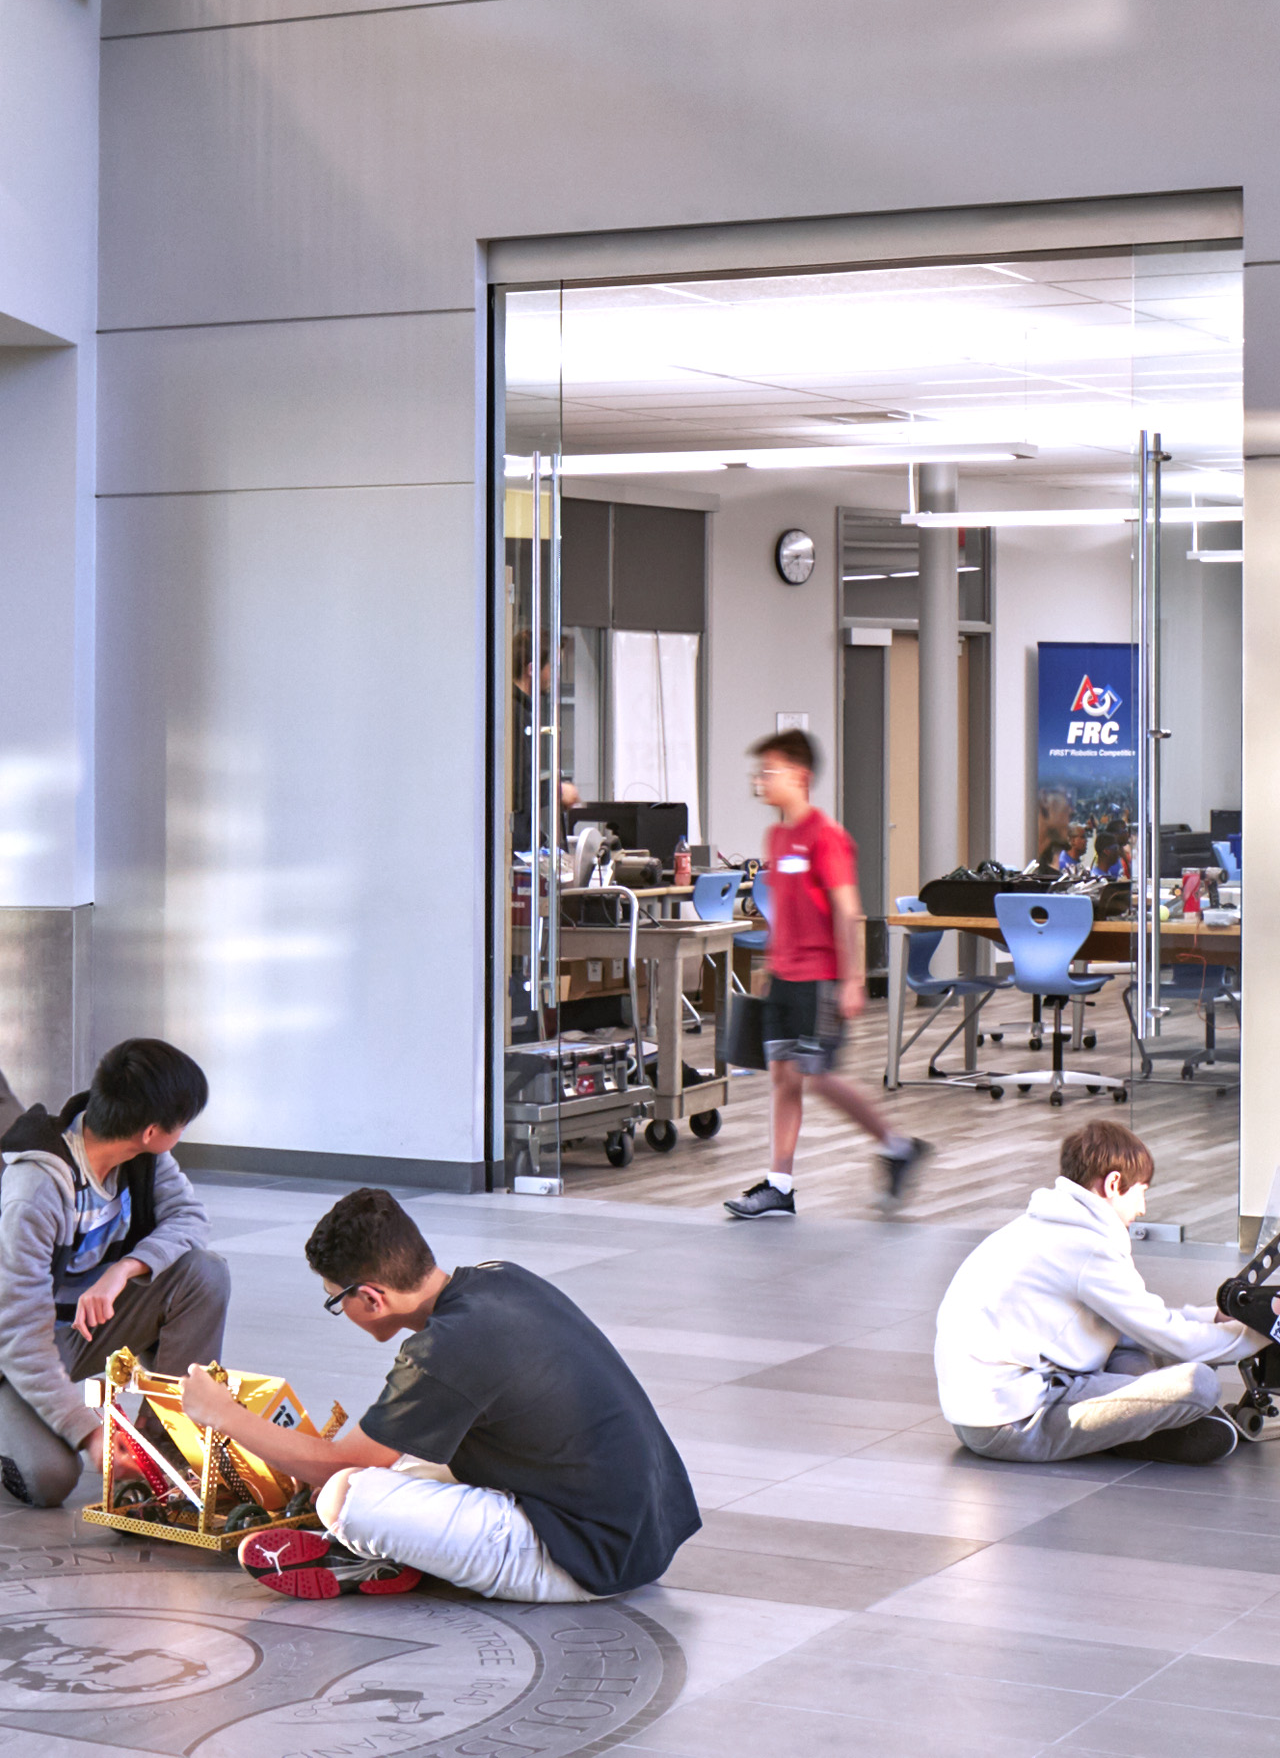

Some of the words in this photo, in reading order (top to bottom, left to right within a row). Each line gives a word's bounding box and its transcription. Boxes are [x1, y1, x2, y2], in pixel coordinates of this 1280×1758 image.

[1067, 721, 1120, 745] FRC
[1049, 749, 1068, 757] FIRST
[1071, 749, 1098, 757] Robotics
[394, 1600, 516, 1666] BRAINTREE
[551, 1627, 641, 1663] OF
[453, 1677, 511, 1706] 1640
[453, 1674, 641, 1758] HOLB
